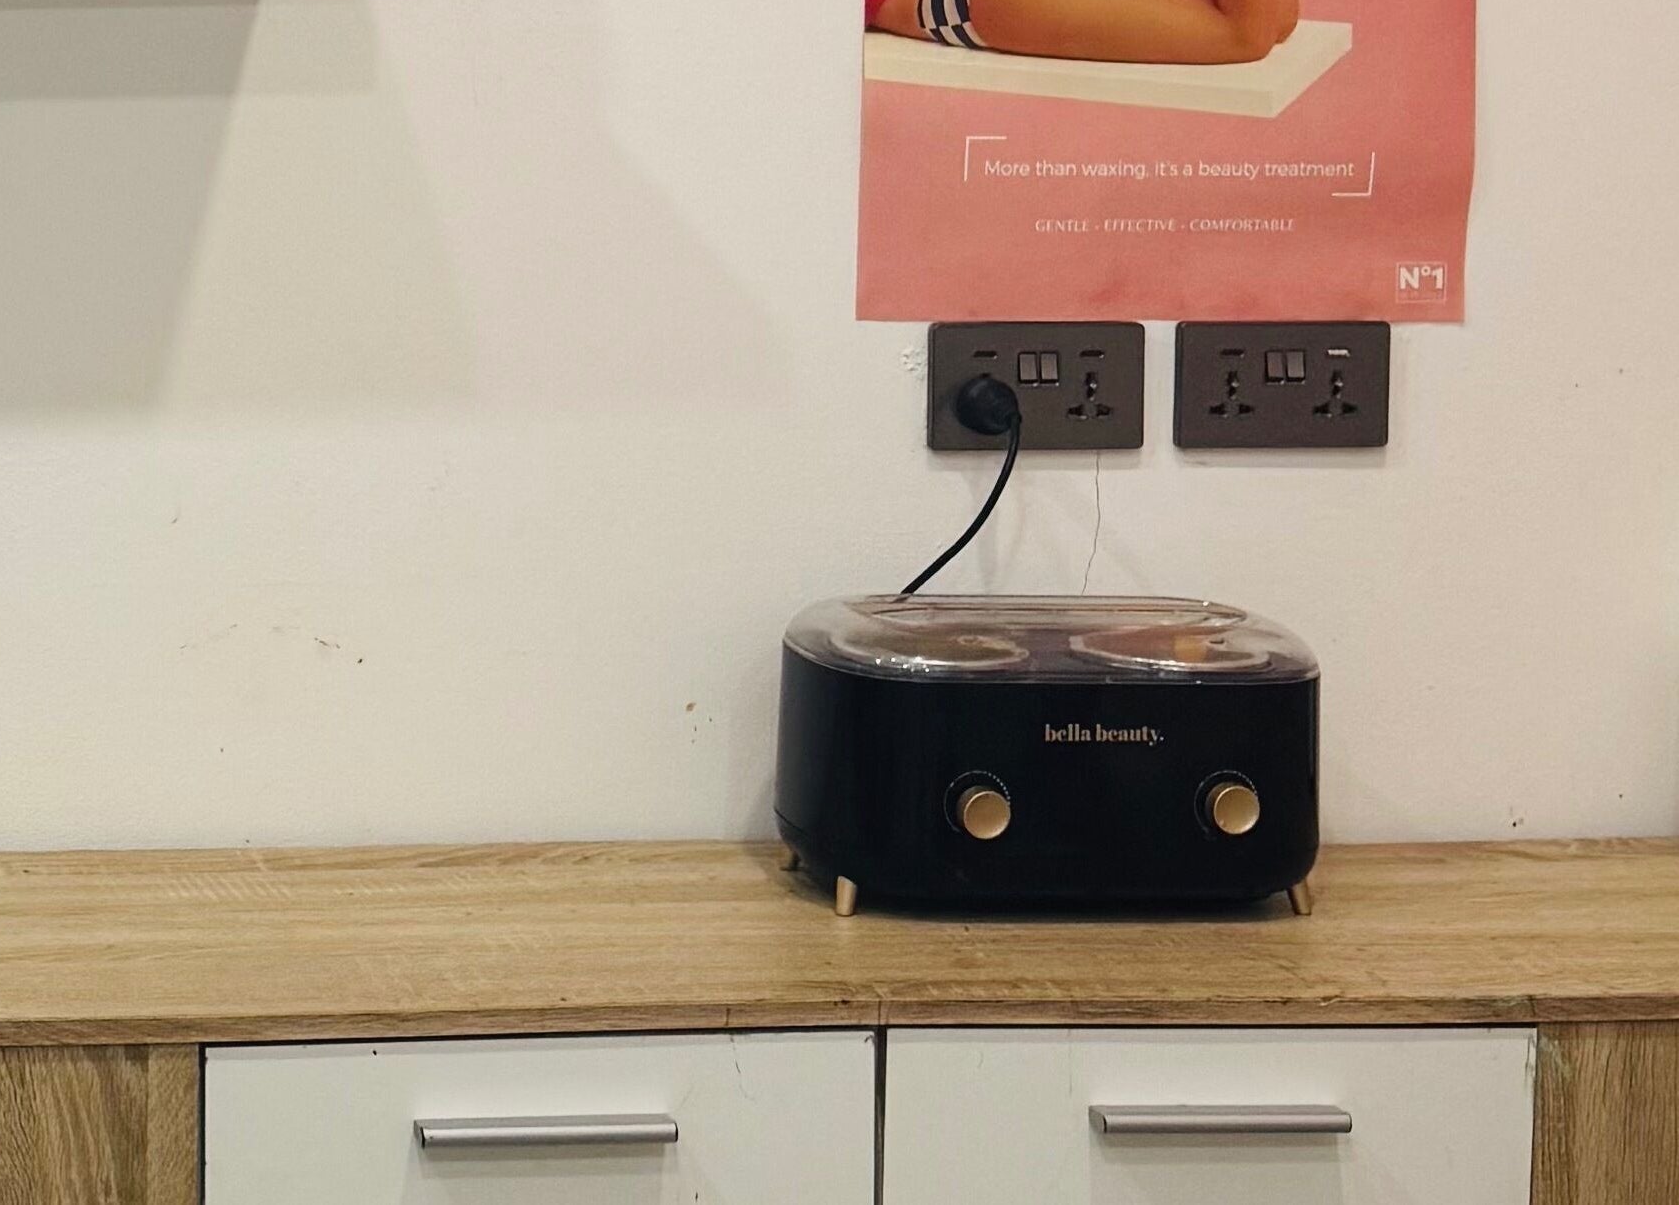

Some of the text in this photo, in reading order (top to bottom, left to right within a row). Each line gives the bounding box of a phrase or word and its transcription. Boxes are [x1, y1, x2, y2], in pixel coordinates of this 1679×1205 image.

[984, 160, 1030, 177] More
[1035, 160, 1077, 177] than
[1182, 164, 1193, 177] a
[1198, 161, 1260, 180] beauty
[1265, 162, 1355, 177] treatment
[1035, 218, 1089, 232] GENTLE
[1104, 219, 1176, 232] EFFECTIVE
[1189, 219, 1295, 232] COMFORTABLE
[1045, 723, 1091, 741] bella
